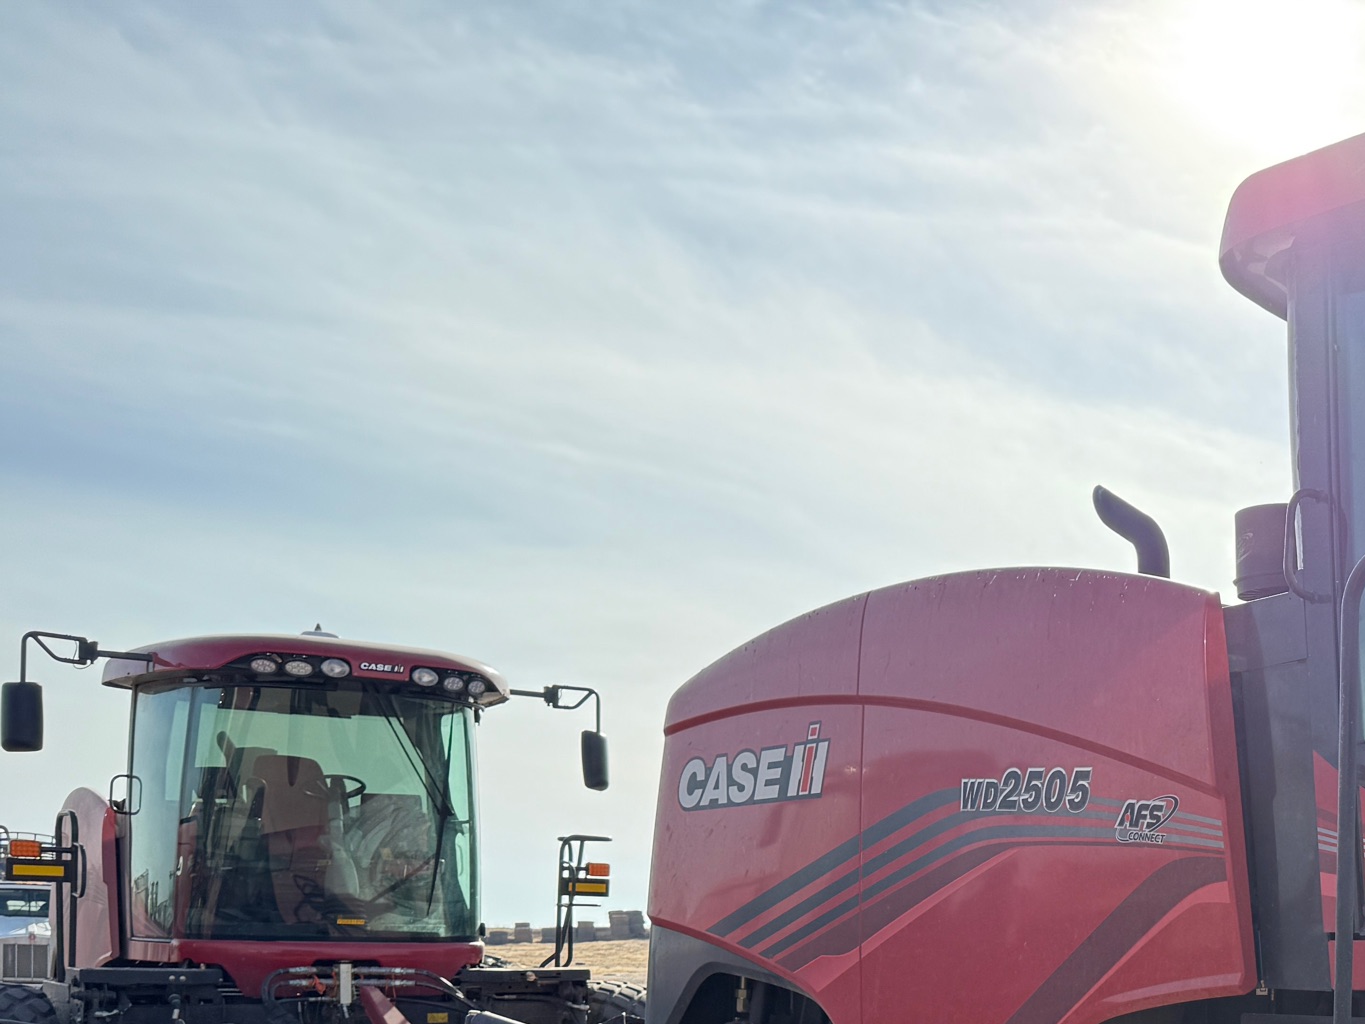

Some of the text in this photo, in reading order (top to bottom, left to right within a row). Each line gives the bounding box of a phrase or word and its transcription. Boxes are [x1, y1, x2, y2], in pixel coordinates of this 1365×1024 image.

[360, 662, 392, 672] CASE
[678, 747, 786, 808] CASE
[960, 767, 1093, 813] WD2505
[1114, 799, 1167, 831] AFS
[1128, 831, 1166, 845] CONNECT
